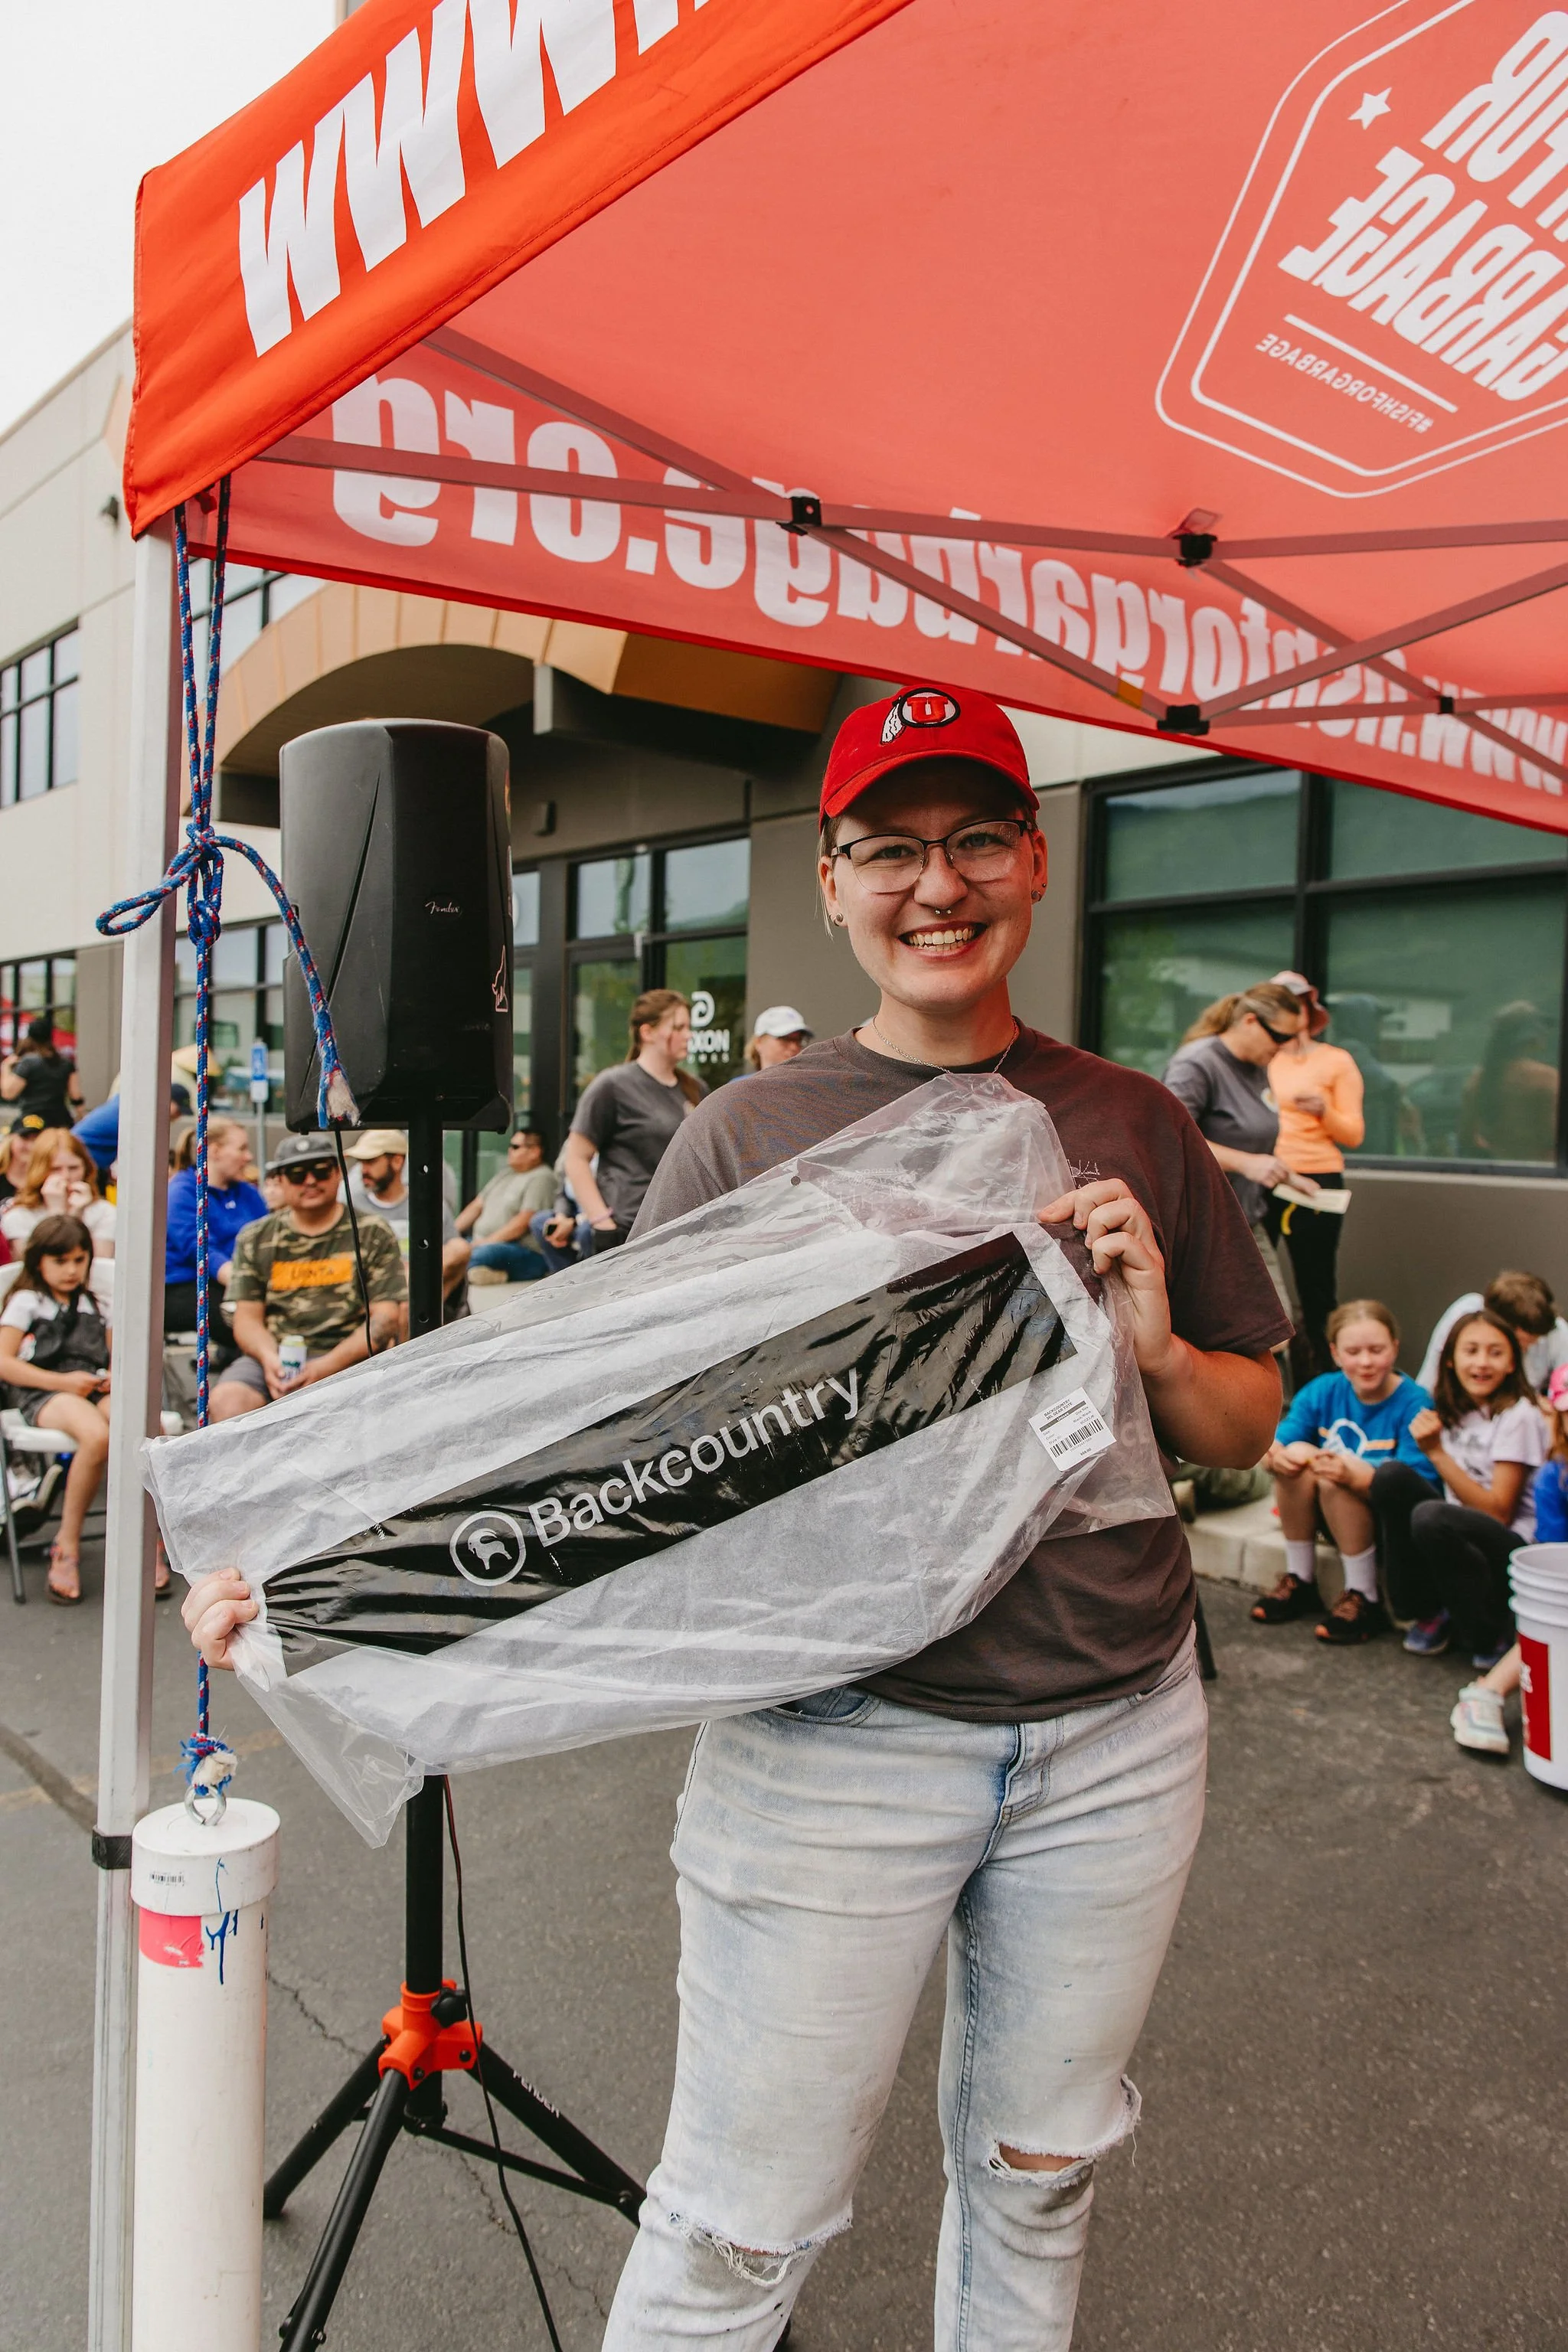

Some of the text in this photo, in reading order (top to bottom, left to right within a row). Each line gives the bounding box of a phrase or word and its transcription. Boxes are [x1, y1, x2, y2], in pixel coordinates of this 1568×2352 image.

[906, 695, 949, 724] U
[1044, 1398, 1070, 1416] BACKCOUNTRY
[528, 1367, 859, 1548] Backcountry
